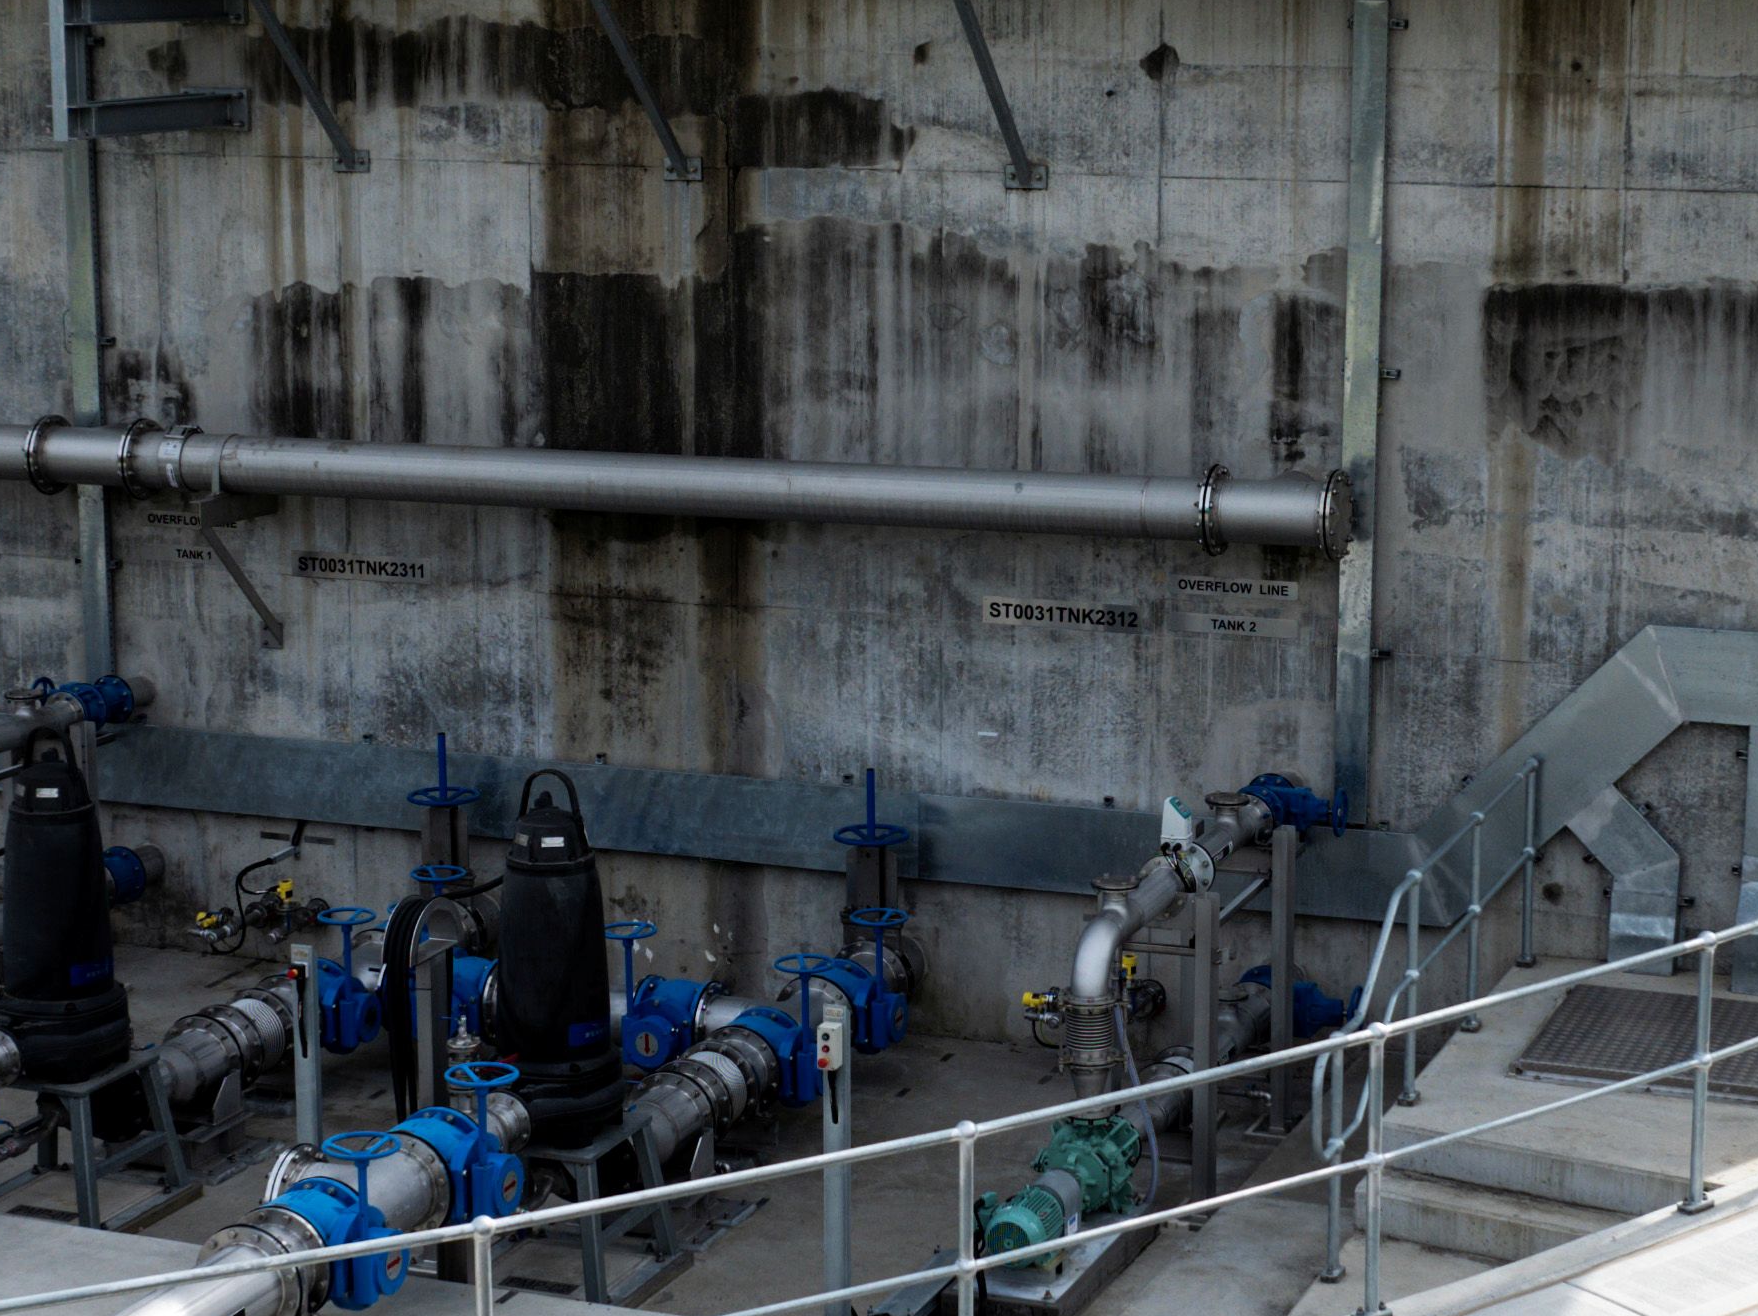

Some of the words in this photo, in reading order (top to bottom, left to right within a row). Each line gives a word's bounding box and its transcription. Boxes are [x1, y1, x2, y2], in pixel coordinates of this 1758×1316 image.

[147, 513, 201, 526] OVERFLO
[175, 548, 204, 560] TANK
[297, 556, 425, 579] ST0031TNK2311
[1177, 578, 1253, 595] OVERFLOW
[1259, 583, 1289, 597] LINE
[988, 602, 1139, 628] ST0031TNK2312
[1210, 618, 1246, 632] TANK
[1248, 621, 1257, 633] 2
